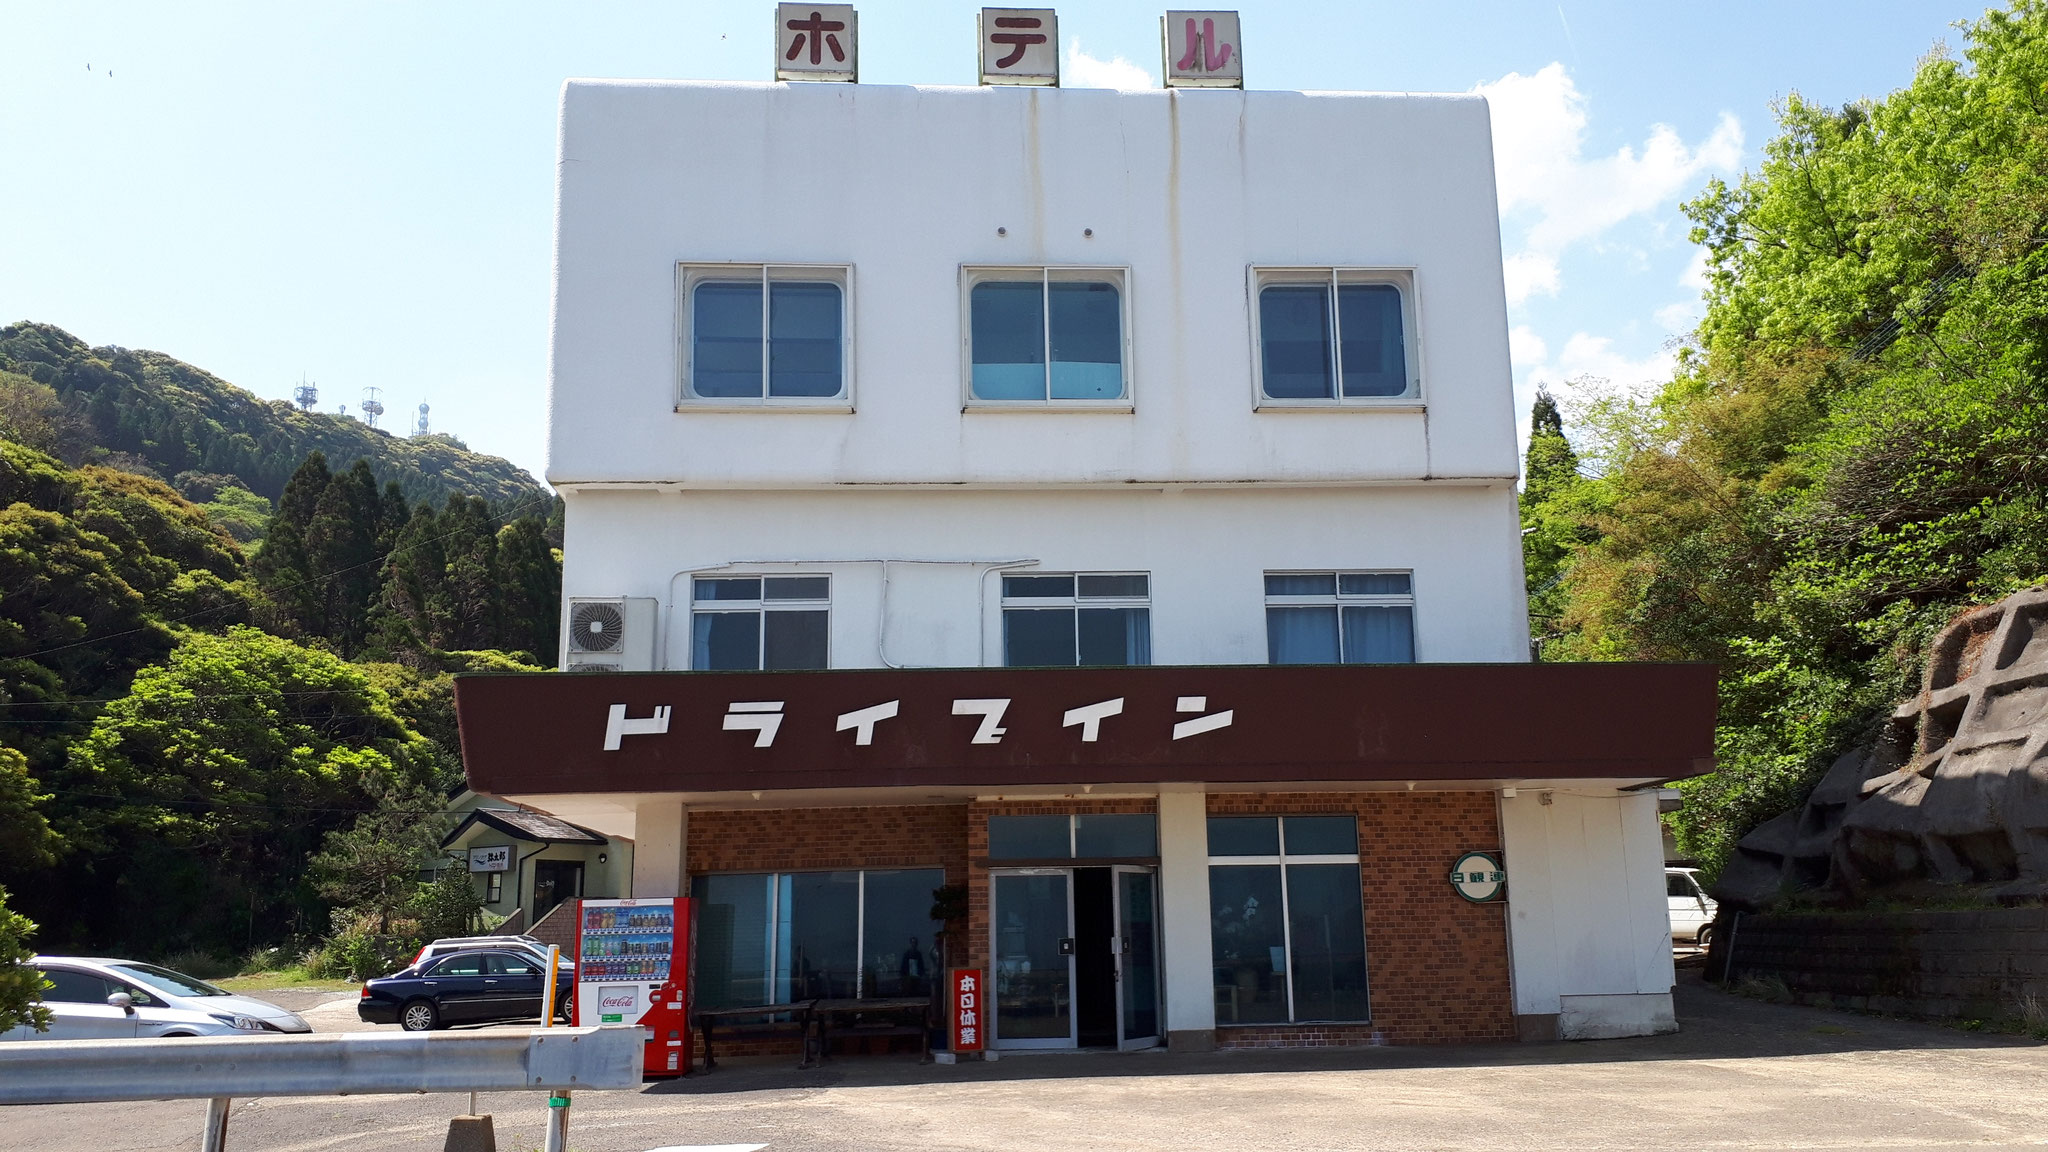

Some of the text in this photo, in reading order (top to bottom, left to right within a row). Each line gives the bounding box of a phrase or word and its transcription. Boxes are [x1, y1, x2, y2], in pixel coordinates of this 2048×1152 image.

[786, 11, 1233, 71] ホテル
[603, 697, 1234, 751] ドライブイン
[960, 975, 976, 1045] 本日休業
